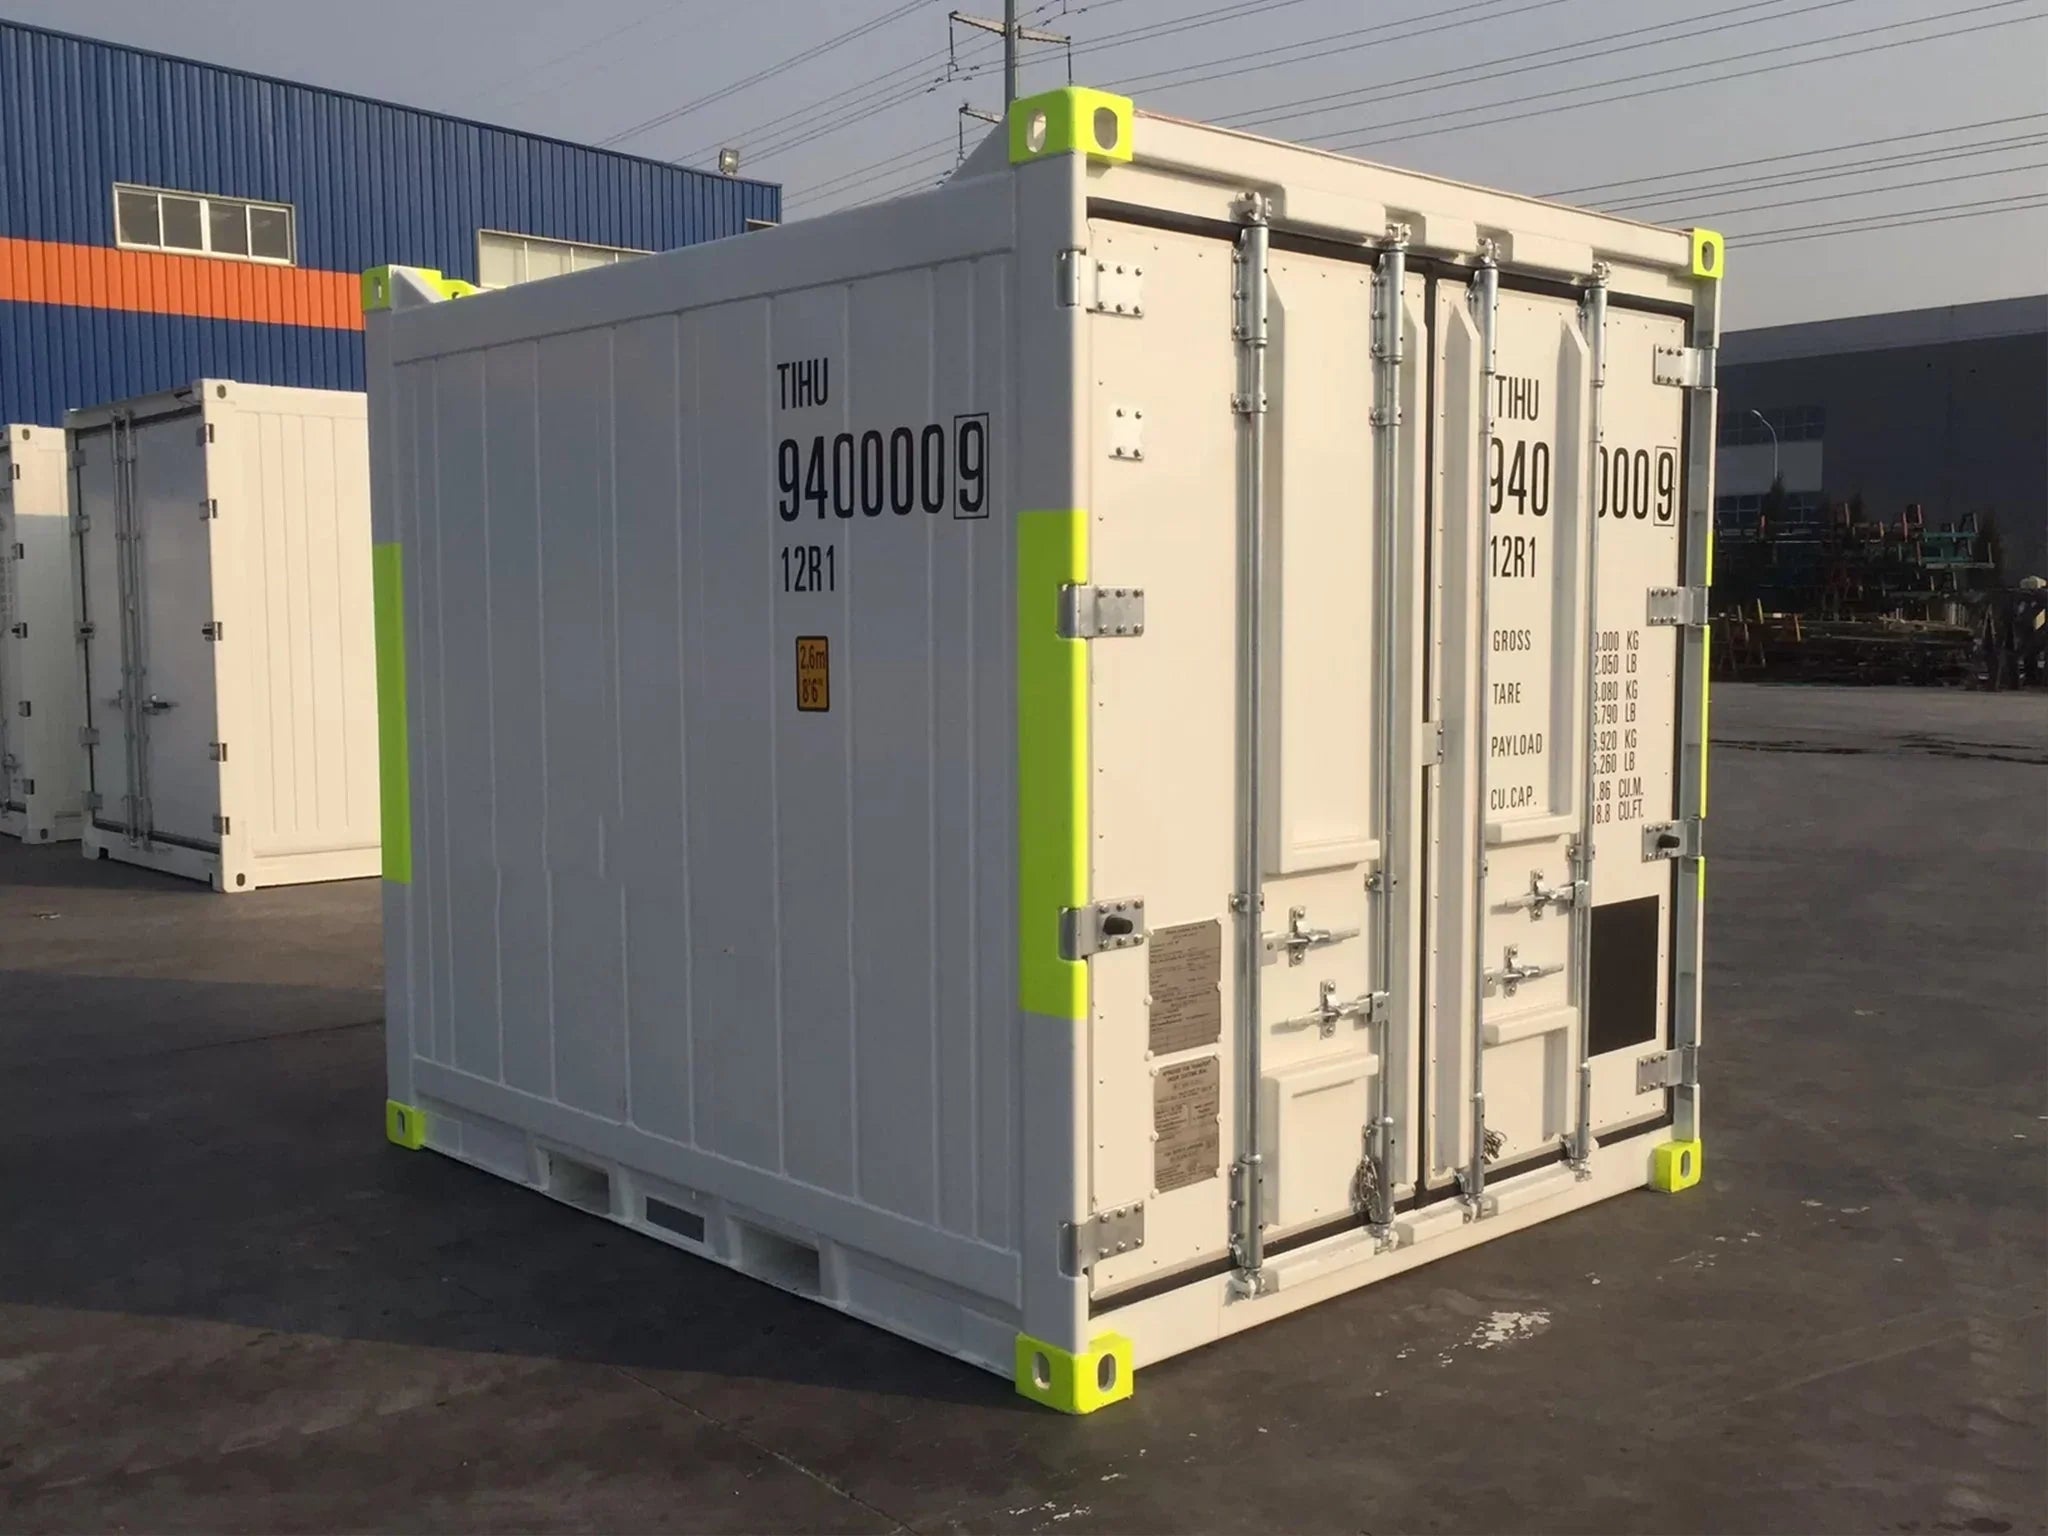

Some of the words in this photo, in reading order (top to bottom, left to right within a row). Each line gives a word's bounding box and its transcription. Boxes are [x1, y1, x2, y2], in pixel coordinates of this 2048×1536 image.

[777, 357, 829, 411] TIHU
[1495, 374, 1539, 422] TIHU
[1489, 436, 1550, 517] 940
[780, 544, 835, 593] 12R1
[1490, 535, 1536, 578] 12R1
[1493, 629, 1532, 652] GROSS
[1627, 630, 1640, 651] KG
[1626, 653, 1637, 673] LB
[1493, 682, 1521, 705] TARE
[1625, 680, 1638, 700] KG
[1625, 702, 1636, 722] LB
[1491, 732, 1543, 758] PAYLOAD
[1624, 728, 1637, 749] KG
[1624, 751, 1635, 771] LB
[1490, 785, 1537, 810] CU.CAP.
